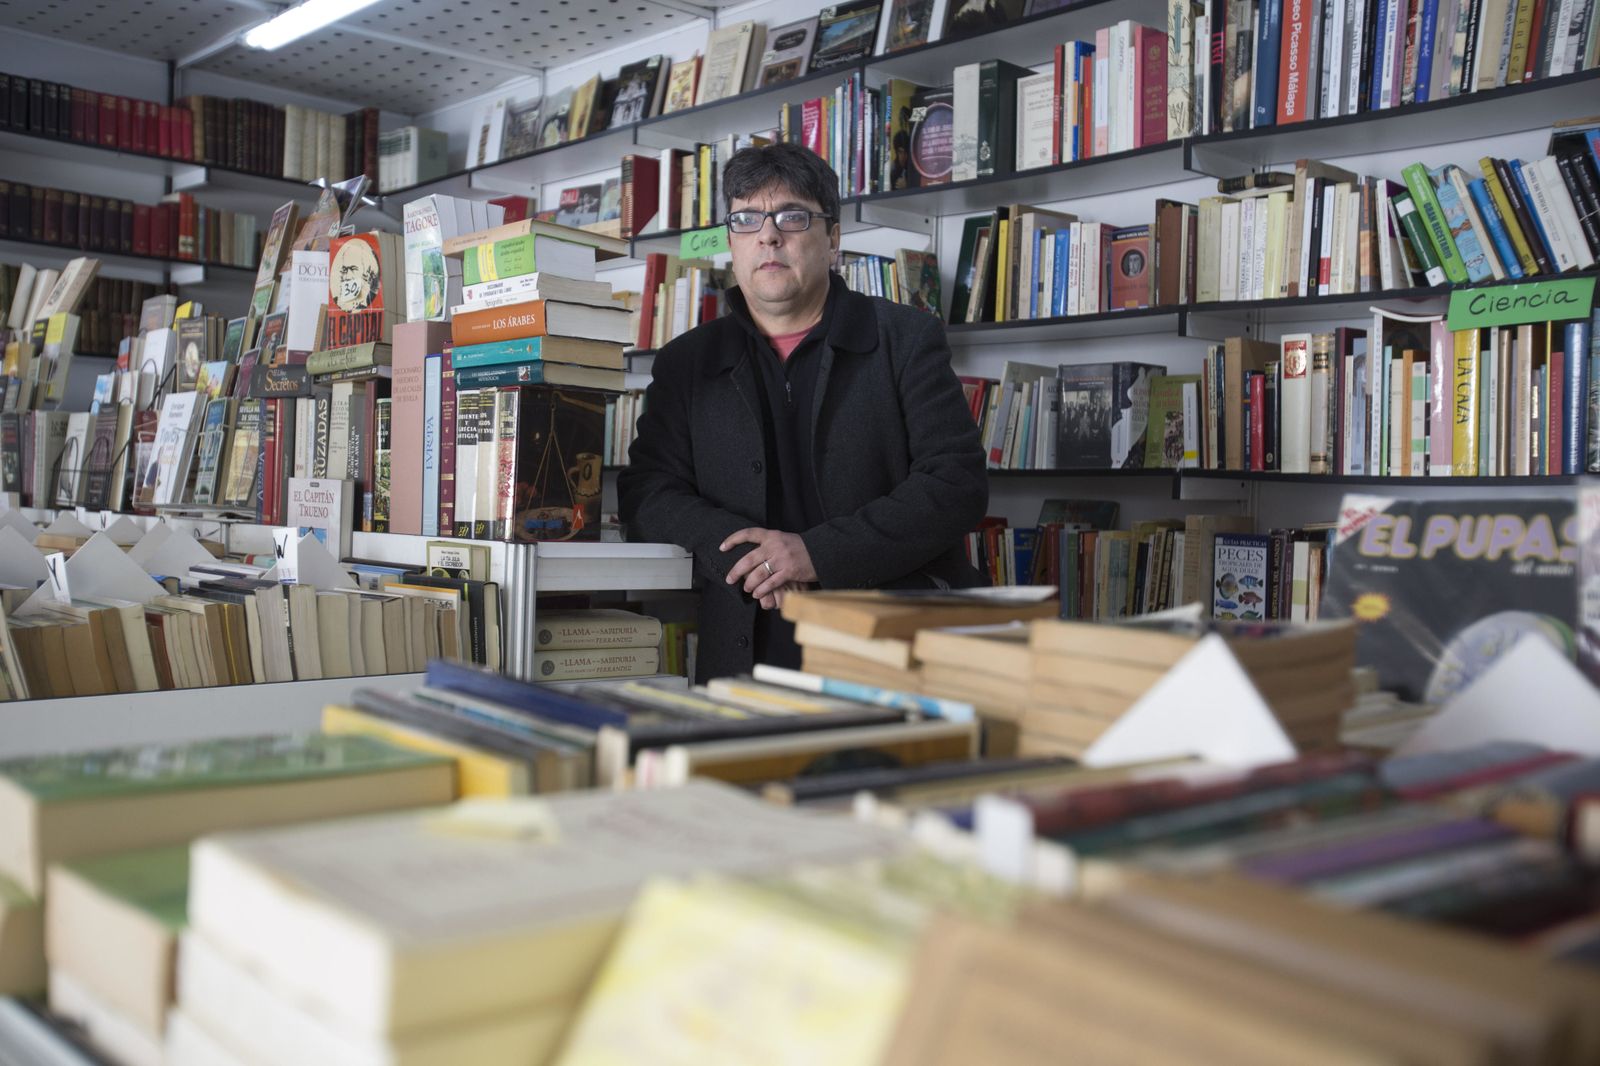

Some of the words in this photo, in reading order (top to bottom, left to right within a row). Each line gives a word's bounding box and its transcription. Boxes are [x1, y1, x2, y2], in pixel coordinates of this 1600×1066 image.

[1288, 22, 1303, 69] Picasso
[1286, 71, 1300, 116] Málaga
[405, 213, 438, 234] TAGORE
[690, 233, 719, 252] Cine
[1468, 289, 1580, 316] Ciencia
[339, 311, 384, 345] CAPITAL
[493, 319, 507, 330] LOS
[507, 313, 536, 328] ÁRABES
[1457, 357, 1473, 378] LA
[264, 369, 299, 391] Secretos
[1456, 381, 1472, 425] CAZA
[314, 398, 327, 479] RUZADAS
[425, 415, 435, 470] EVROPA
[293, 490, 303, 502] EL
[304, 489, 335, 504] CAPITÁN
[299, 503, 329, 518] TRUENO
[1359, 514, 1417, 559] EL
[1218, 548, 1264, 561] PECES
[562, 628, 591, 637] LLAMA
[564, 658, 592, 666] LLAMA
